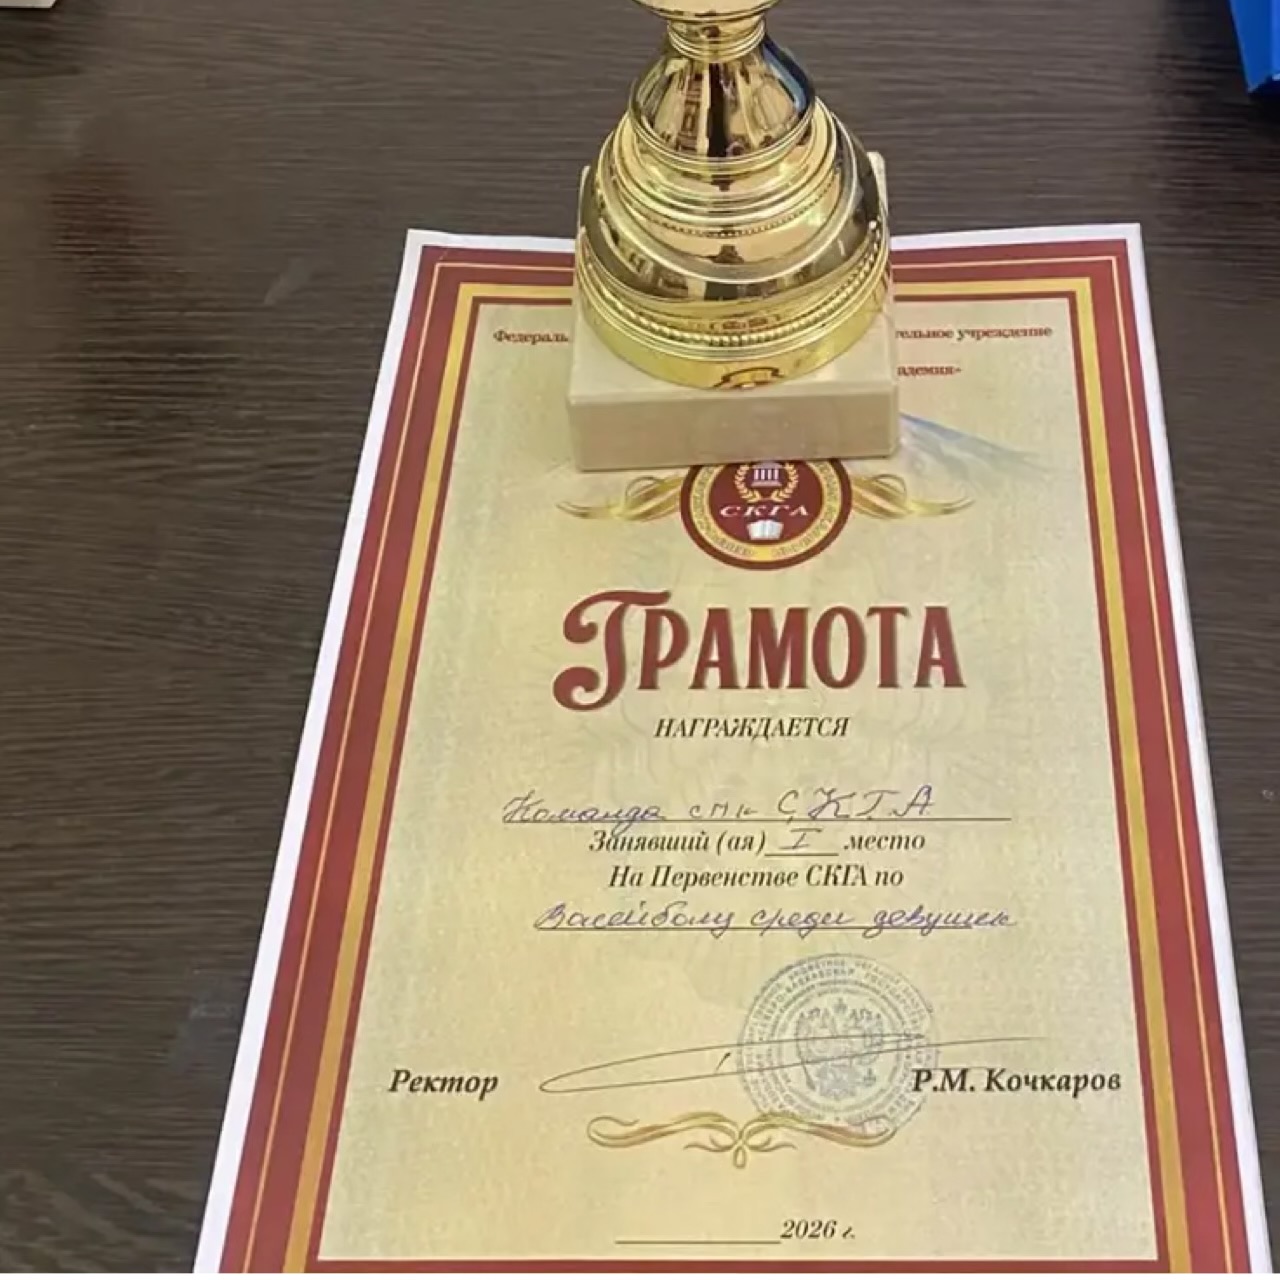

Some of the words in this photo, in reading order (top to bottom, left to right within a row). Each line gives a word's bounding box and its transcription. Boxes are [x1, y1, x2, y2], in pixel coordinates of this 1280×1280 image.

[719, 505, 809, 518] СКГА
[553, 590, 966, 712] ГРАМОТА
[654, 716, 850, 741] НАГРАЖДАЕТСЯ
[589, 829, 711, 852] Занявший
[715, 830, 766, 856] (ая)
[844, 833, 926, 851] место
[608, 865, 643, 888] На
[650, 865, 799, 893] Первенстве
[805, 865, 870, 888] СКГА
[874, 870, 904, 888] по
[388, 1068, 499, 1098] Ректор
[911, 1068, 978, 1094] Р.М.
[984, 1068, 1122, 1095] Кочкаров
[781, 1219, 838, 1241] 2026
